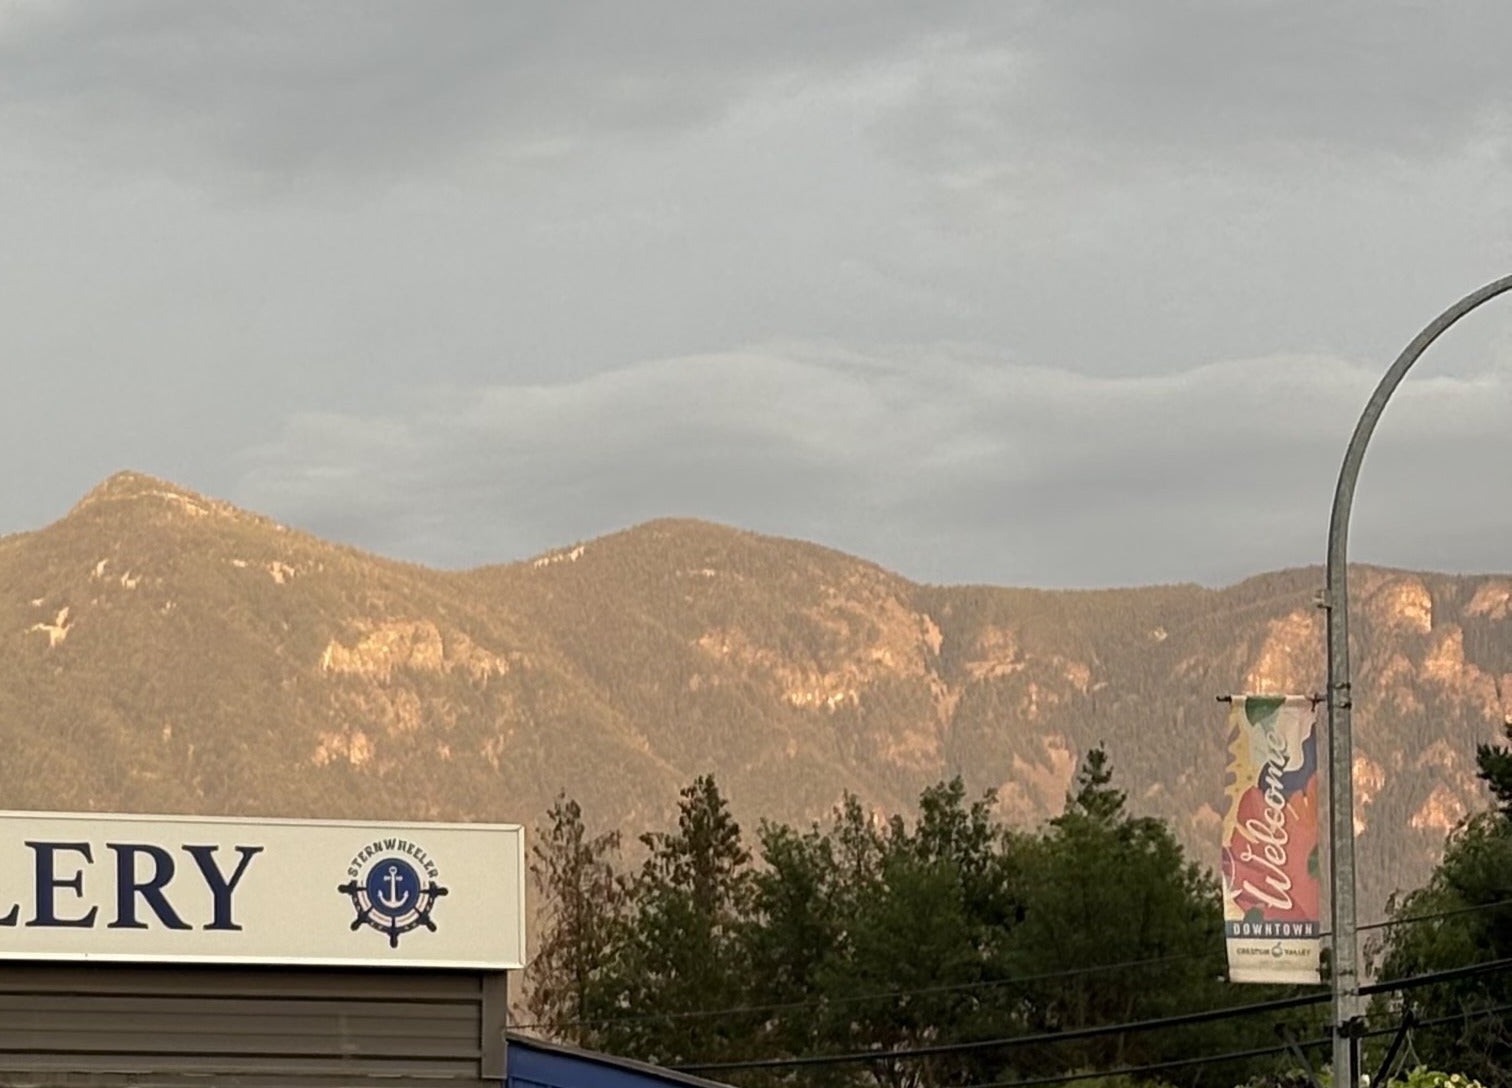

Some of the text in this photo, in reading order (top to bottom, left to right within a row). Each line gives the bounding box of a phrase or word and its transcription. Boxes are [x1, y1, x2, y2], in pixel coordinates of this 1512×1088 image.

[1240, 731, 1293, 909] Welcome
[348, 838, 439, 877] STERNWHEELER
[1233, 923, 1312, 936] DOWNTOWN
